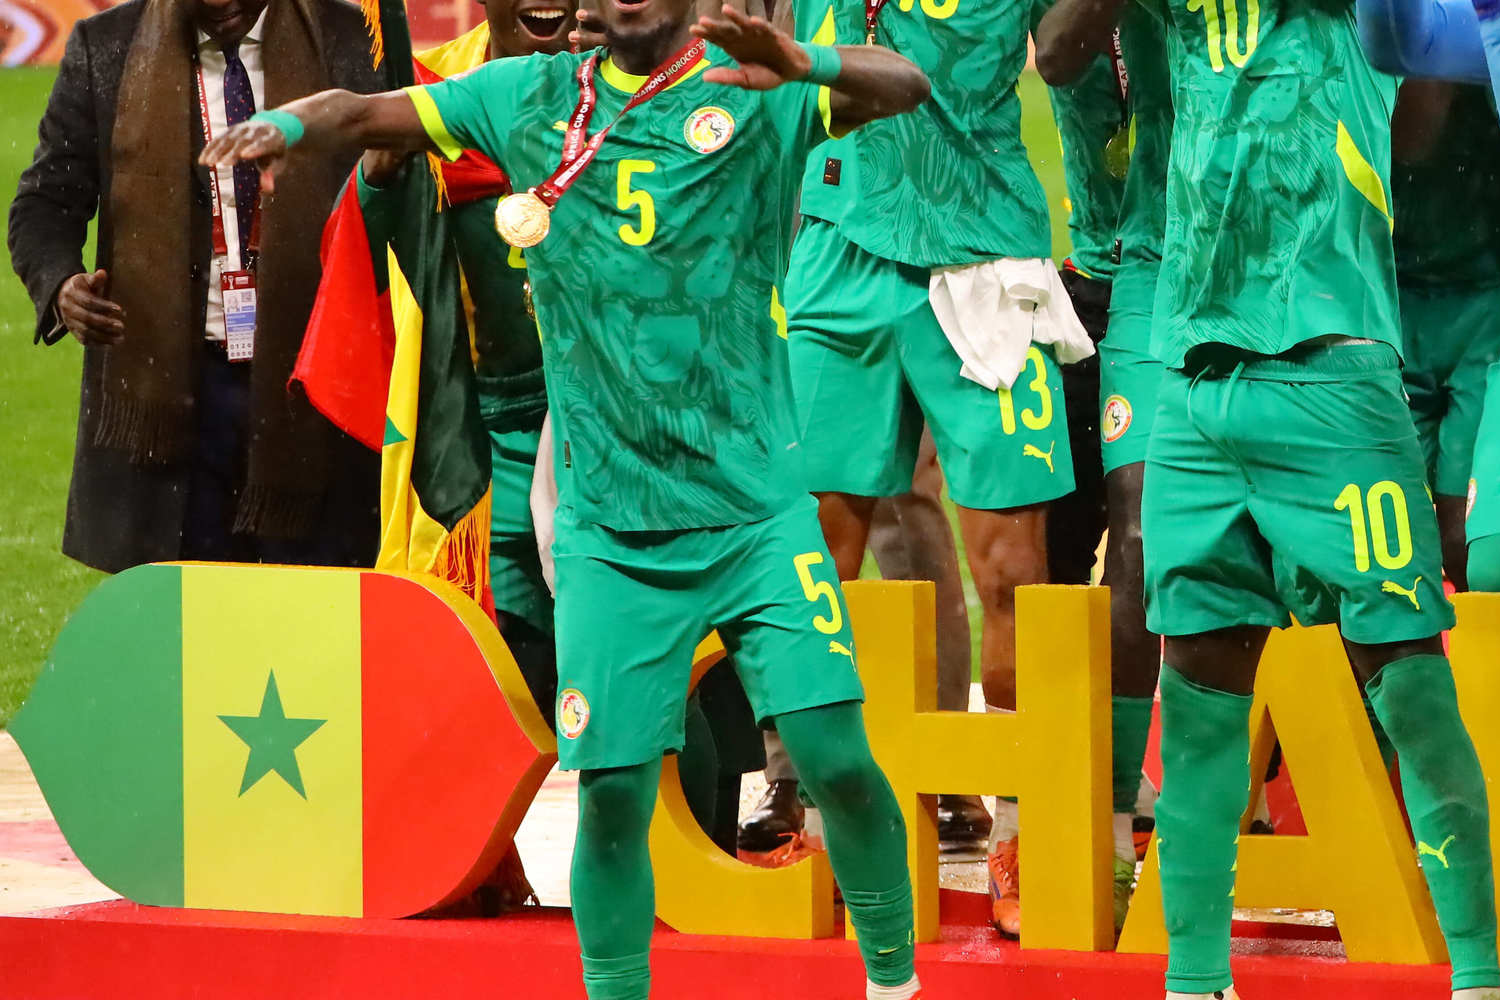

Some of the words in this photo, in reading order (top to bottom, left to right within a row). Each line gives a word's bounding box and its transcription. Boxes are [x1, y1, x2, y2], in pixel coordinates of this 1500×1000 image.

[634, 72, 667, 99] NATIONS
[664, 47, 700, 79] MOROCCO
[573, 114, 585, 128] CUP
[617, 159, 656, 246] 5
[998, 346, 1053, 435] 13
[1334, 480, 1413, 573] 10
[793, 552, 842, 634] 5
